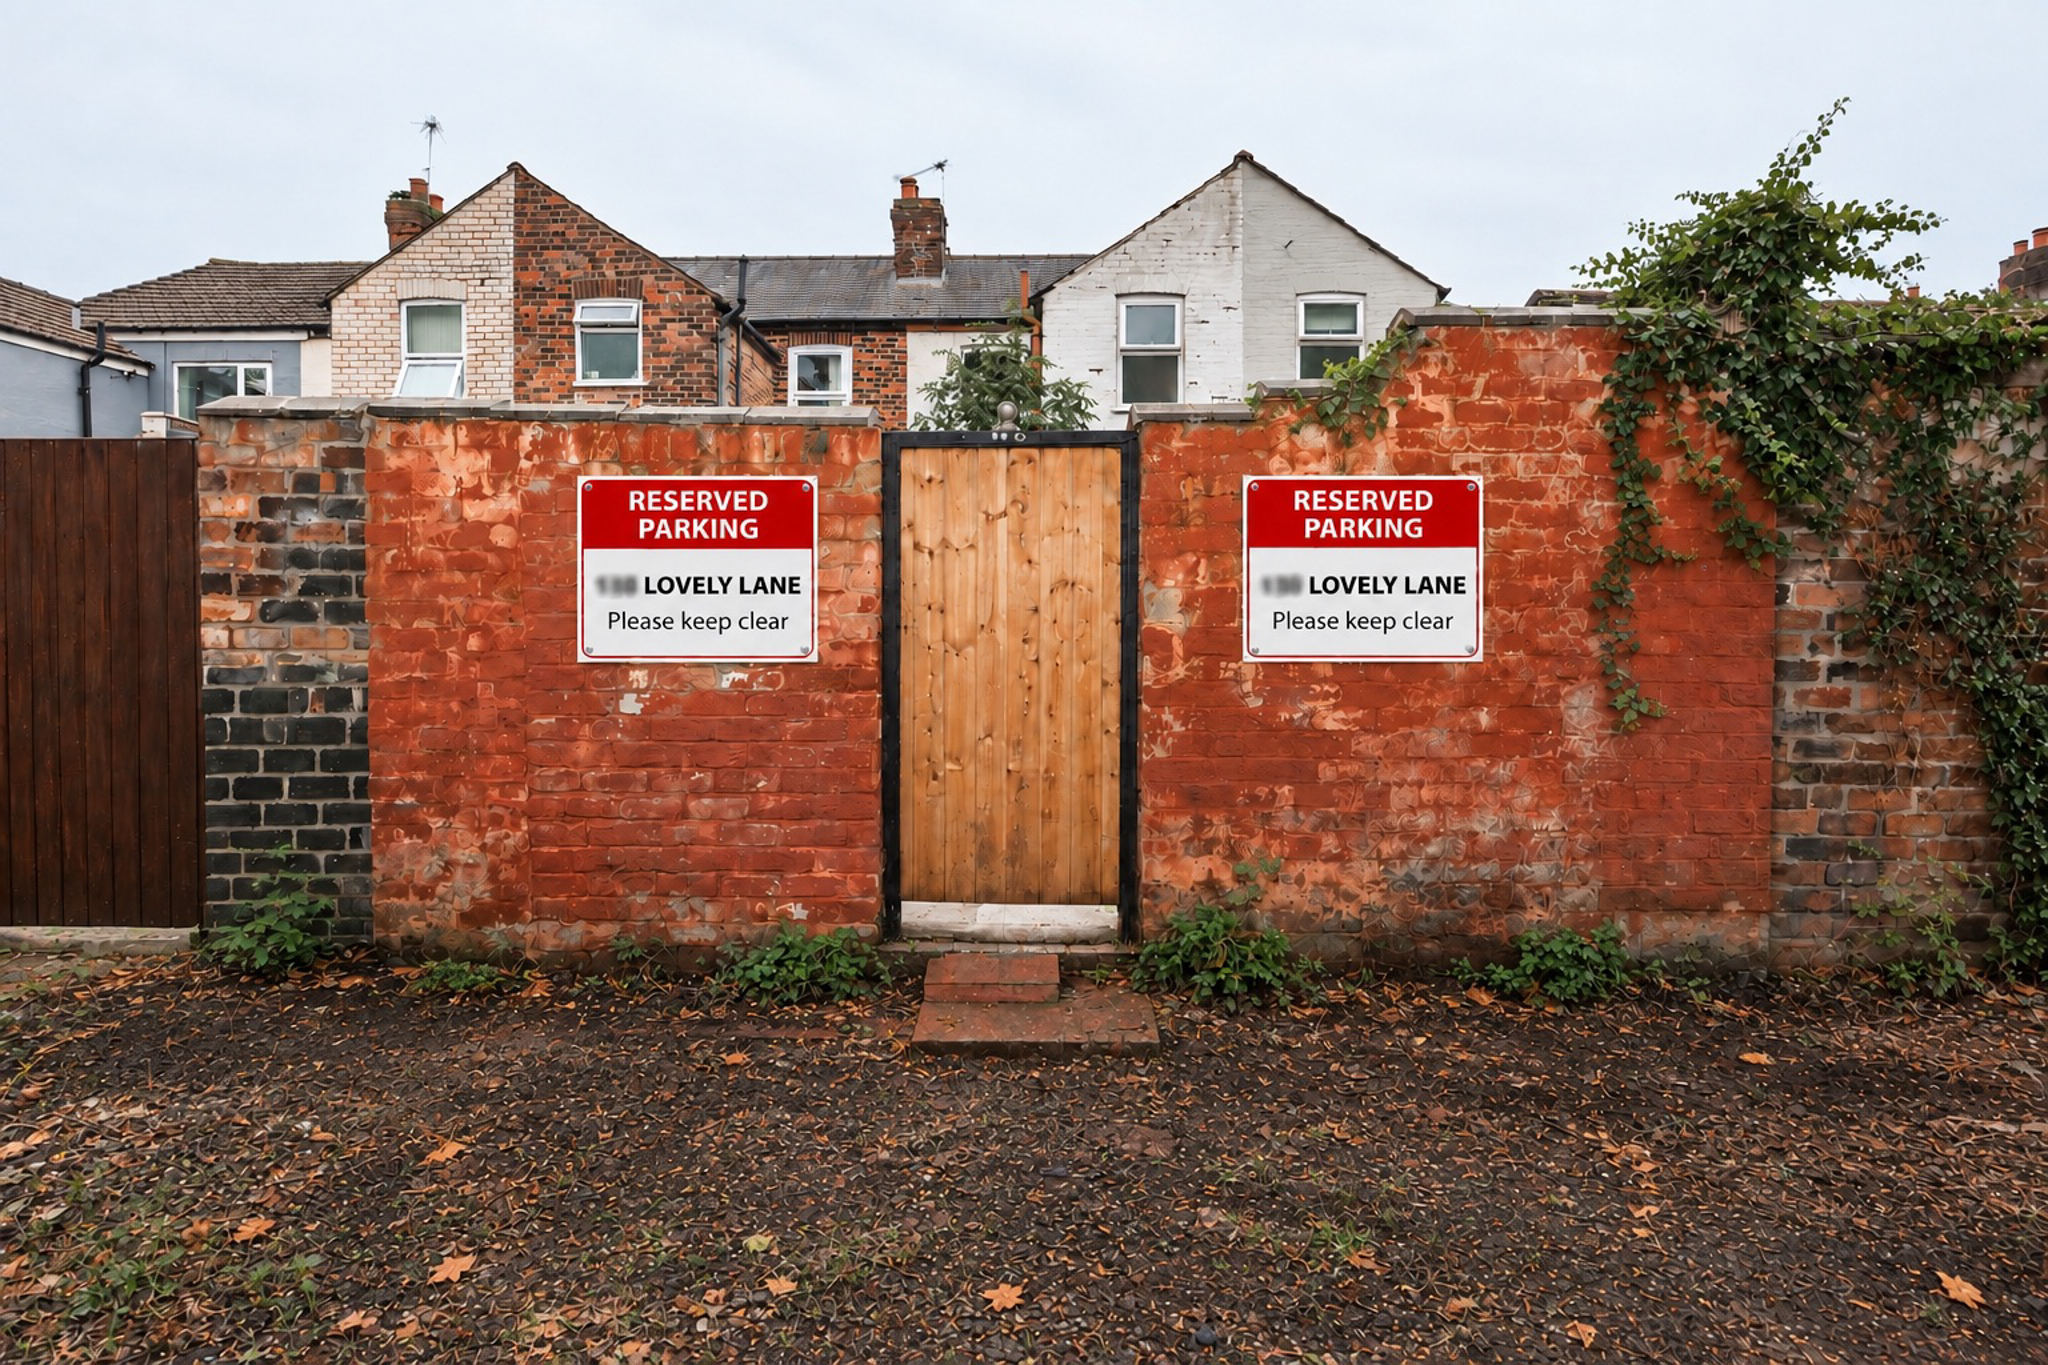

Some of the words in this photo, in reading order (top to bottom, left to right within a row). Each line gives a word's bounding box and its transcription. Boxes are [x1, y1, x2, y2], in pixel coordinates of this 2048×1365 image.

[629, 490, 768, 512] RESERVED
[1294, 490, 1433, 511] RESERVED
[638, 518, 759, 539] PARKING
[1304, 517, 1424, 539] PARKING
[644, 576, 733, 595] LOVELY
[739, 576, 801, 595] LANE
[1309, 576, 1398, 595] LOVELY
[1404, 576, 1466, 595] LANE
[608, 611, 674, 630] Please
[681, 611, 732, 635] keep
[738, 611, 789, 630] clear
[1272, 611, 1339, 630] Please
[1346, 611, 1396, 635] keep
[1402, 611, 1454, 630] clear
